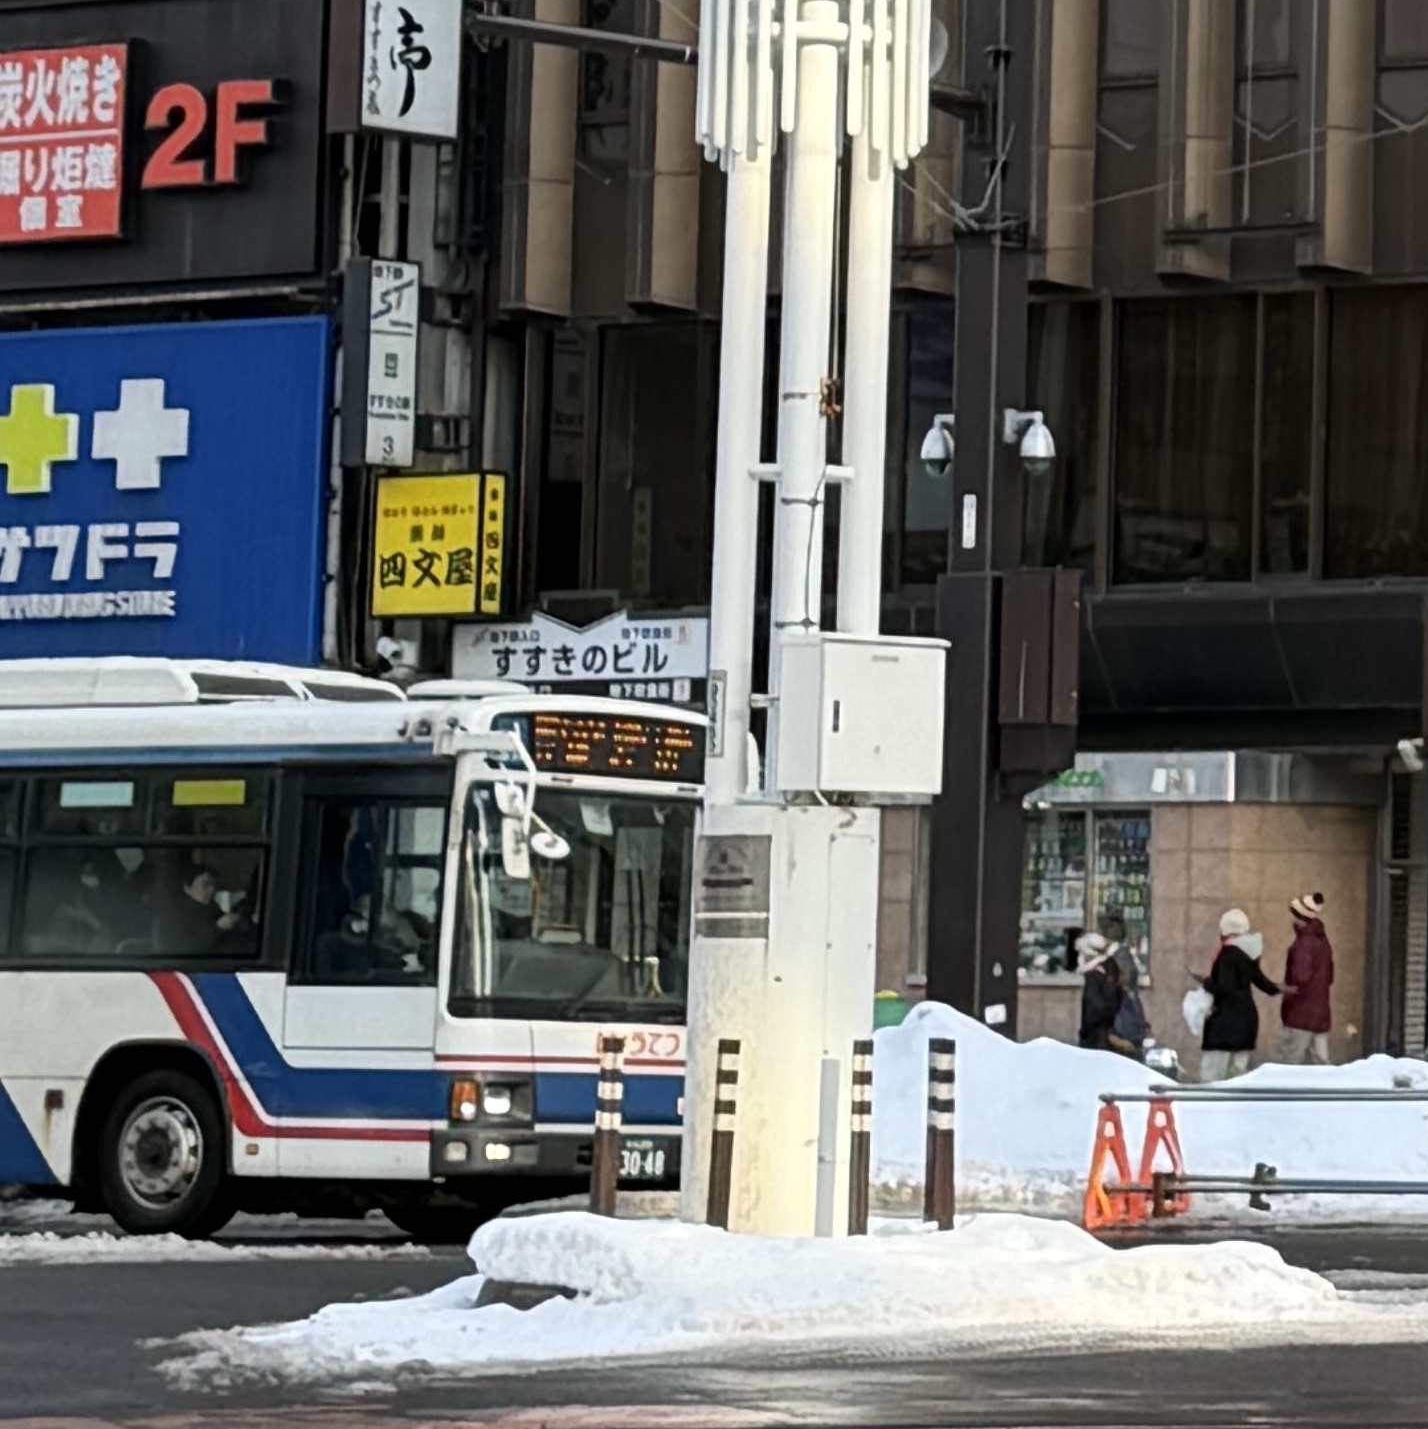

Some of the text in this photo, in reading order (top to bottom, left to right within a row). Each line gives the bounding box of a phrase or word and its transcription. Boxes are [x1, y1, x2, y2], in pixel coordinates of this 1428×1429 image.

[141, 79, 272, 189] 2F
[491, 641, 669, 677] すすきのビル
